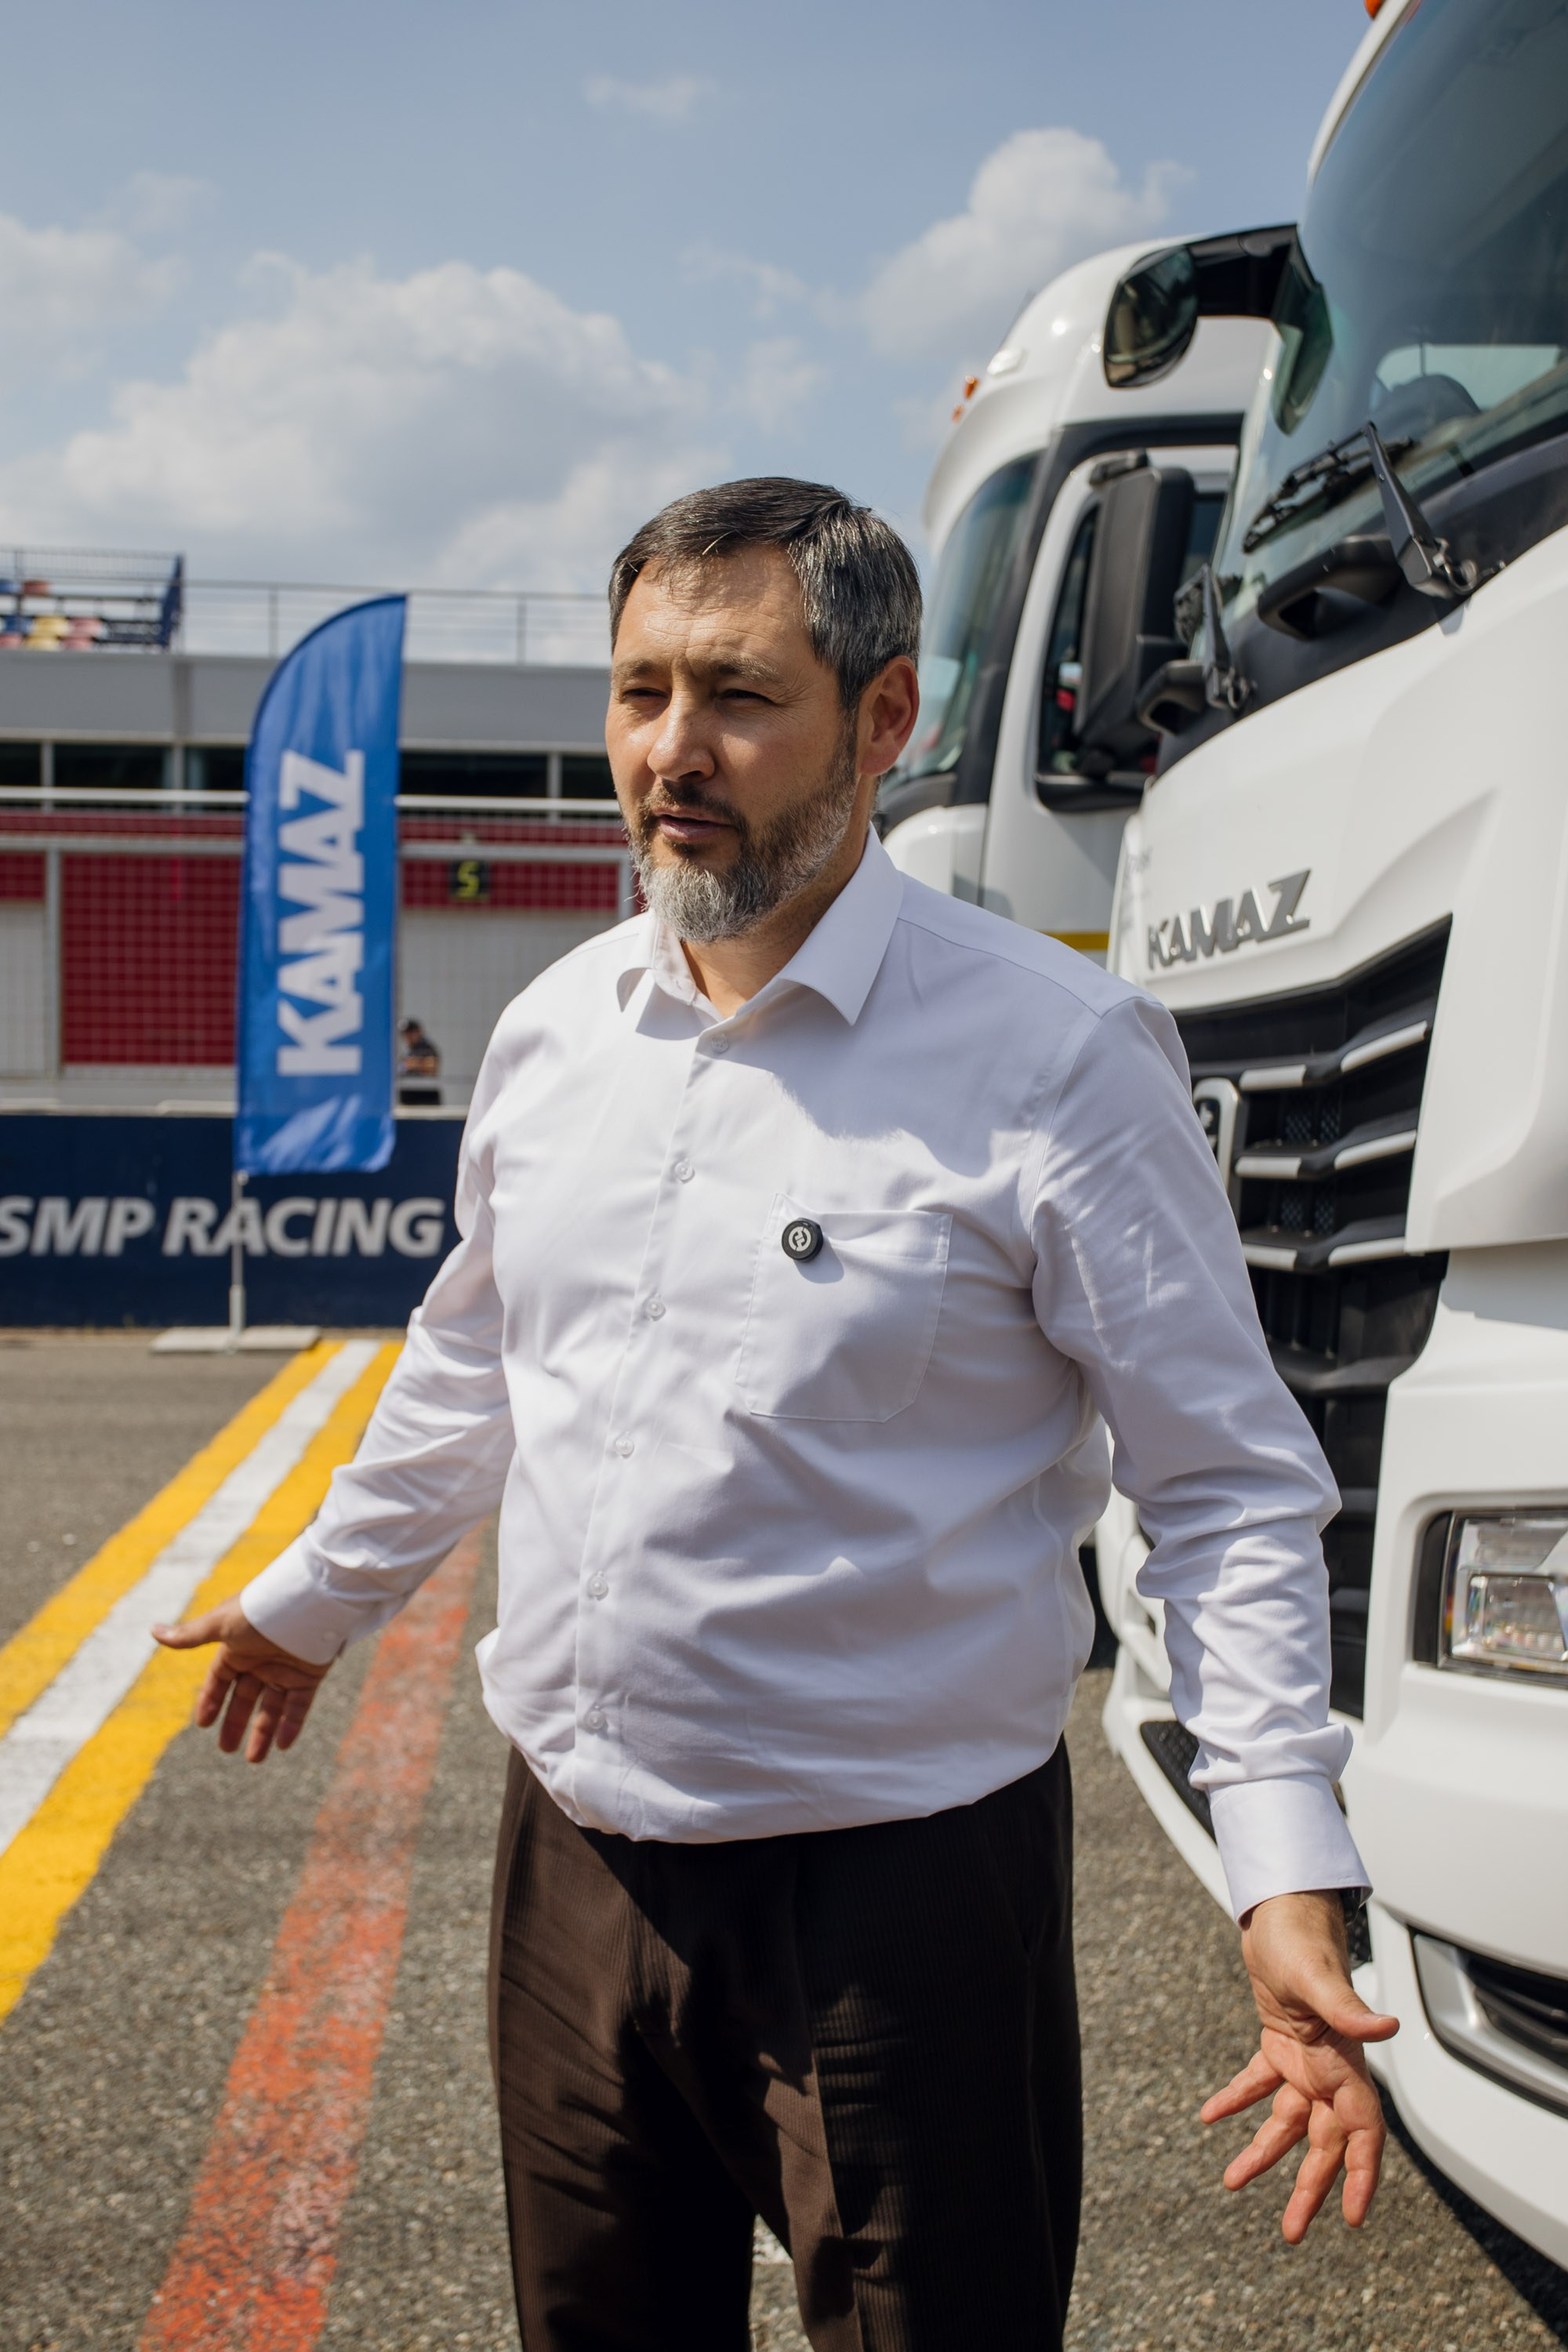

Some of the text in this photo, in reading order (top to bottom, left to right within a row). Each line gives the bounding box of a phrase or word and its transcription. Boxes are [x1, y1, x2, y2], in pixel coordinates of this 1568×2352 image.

[278, 749, 365, 1076] KAMAZ
[1148, 869, 1312, 971] KAMAZ
[0, 1195, 445, 1257] SMP RACING
